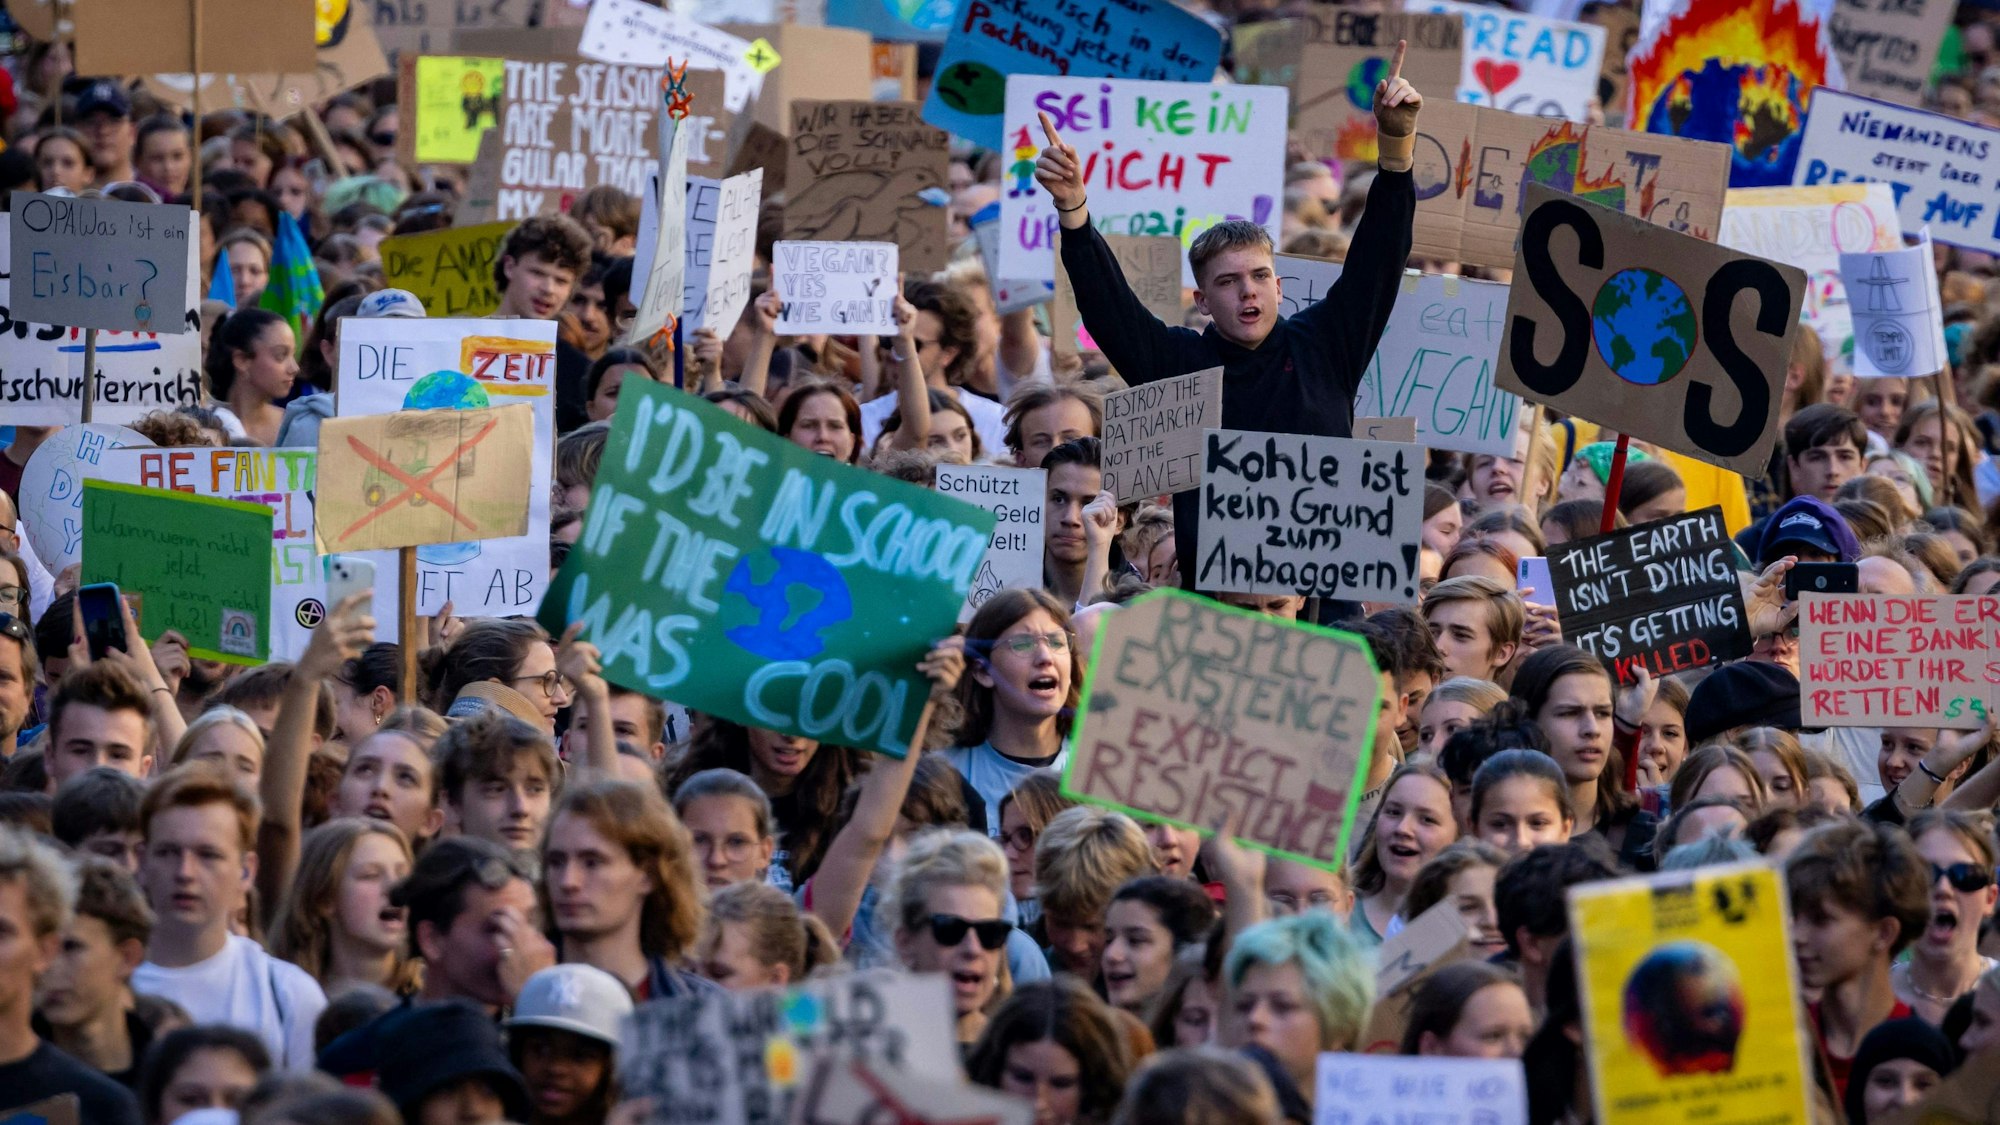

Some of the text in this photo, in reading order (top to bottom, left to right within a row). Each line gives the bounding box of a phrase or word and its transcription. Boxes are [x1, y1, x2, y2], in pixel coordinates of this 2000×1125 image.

[963, 0, 1071, 76] Packung
[1066, 30, 1134, 74] jetzt
[1161, 41, 1204, 70] der
[503, 59, 568, 102] THE
[503, 102, 559, 149] ARE
[570, 106, 653, 158] MORE
[794, 133, 842, 155] DIE
[501, 147, 588, 189] GULAR
[1083, 140, 1232, 193] iCHT
[496, 188, 545, 222] MY
[1921, 190, 1985, 230] AUF
[129, 214, 155, 241] ist
[163, 224, 186, 241] ein
[780, 246, 890, 277] VEGAN?
[782, 272, 828, 299] YES
[1419, 300, 1503, 343] eat
[358, 343, 556, 382] DIE ZEIT
[1105, 375, 1201, 422] DESTROY THE
[1375, 347, 1517, 443] VEGAN
[1104, 400, 1205, 450] PATRIARCHY
[1103, 452, 1200, 501] PLANET
[1104, 441, 1165, 470] NOT THE
[1206, 433, 1410, 497] Kohle ist
[625, 393, 991, 594] I'D BE IN SCHOOL
[939, 473, 1021, 496] Schützt
[993, 503, 1041, 524] Geld
[1206, 482, 1395, 539] kein Grund
[207, 530, 252, 558] nicht
[581, 483, 740, 614] IF THE
[1265, 525, 1342, 551] zum
[1559, 513, 1720, 579] THE EARTH
[483, 568, 534, 608] AB
[1199, 535, 1419, 599] Anbaggern!
[1568, 548, 1737, 613] ISN'T DYING,
[566, 572, 700, 689] WAS
[1575, 593, 1739, 659] IT'S GETTING
[1808, 598, 1877, 626] WENN
[1883, 598, 1938, 626] DIE
[1154, 596, 1366, 688] RESPECT
[1819, 627, 1901, 656] EINE
[1905, 626, 1991, 654] BANK
[1113, 634, 1359, 742] EXISTENCE
[1808, 657, 1913, 683] WÜRDET
[1918, 656, 1975, 684] IHR
[744, 656, 910, 759] COOL
[1808, 685, 1941, 718] RETTEN!
[1126, 706, 1298, 808] EXPECT
